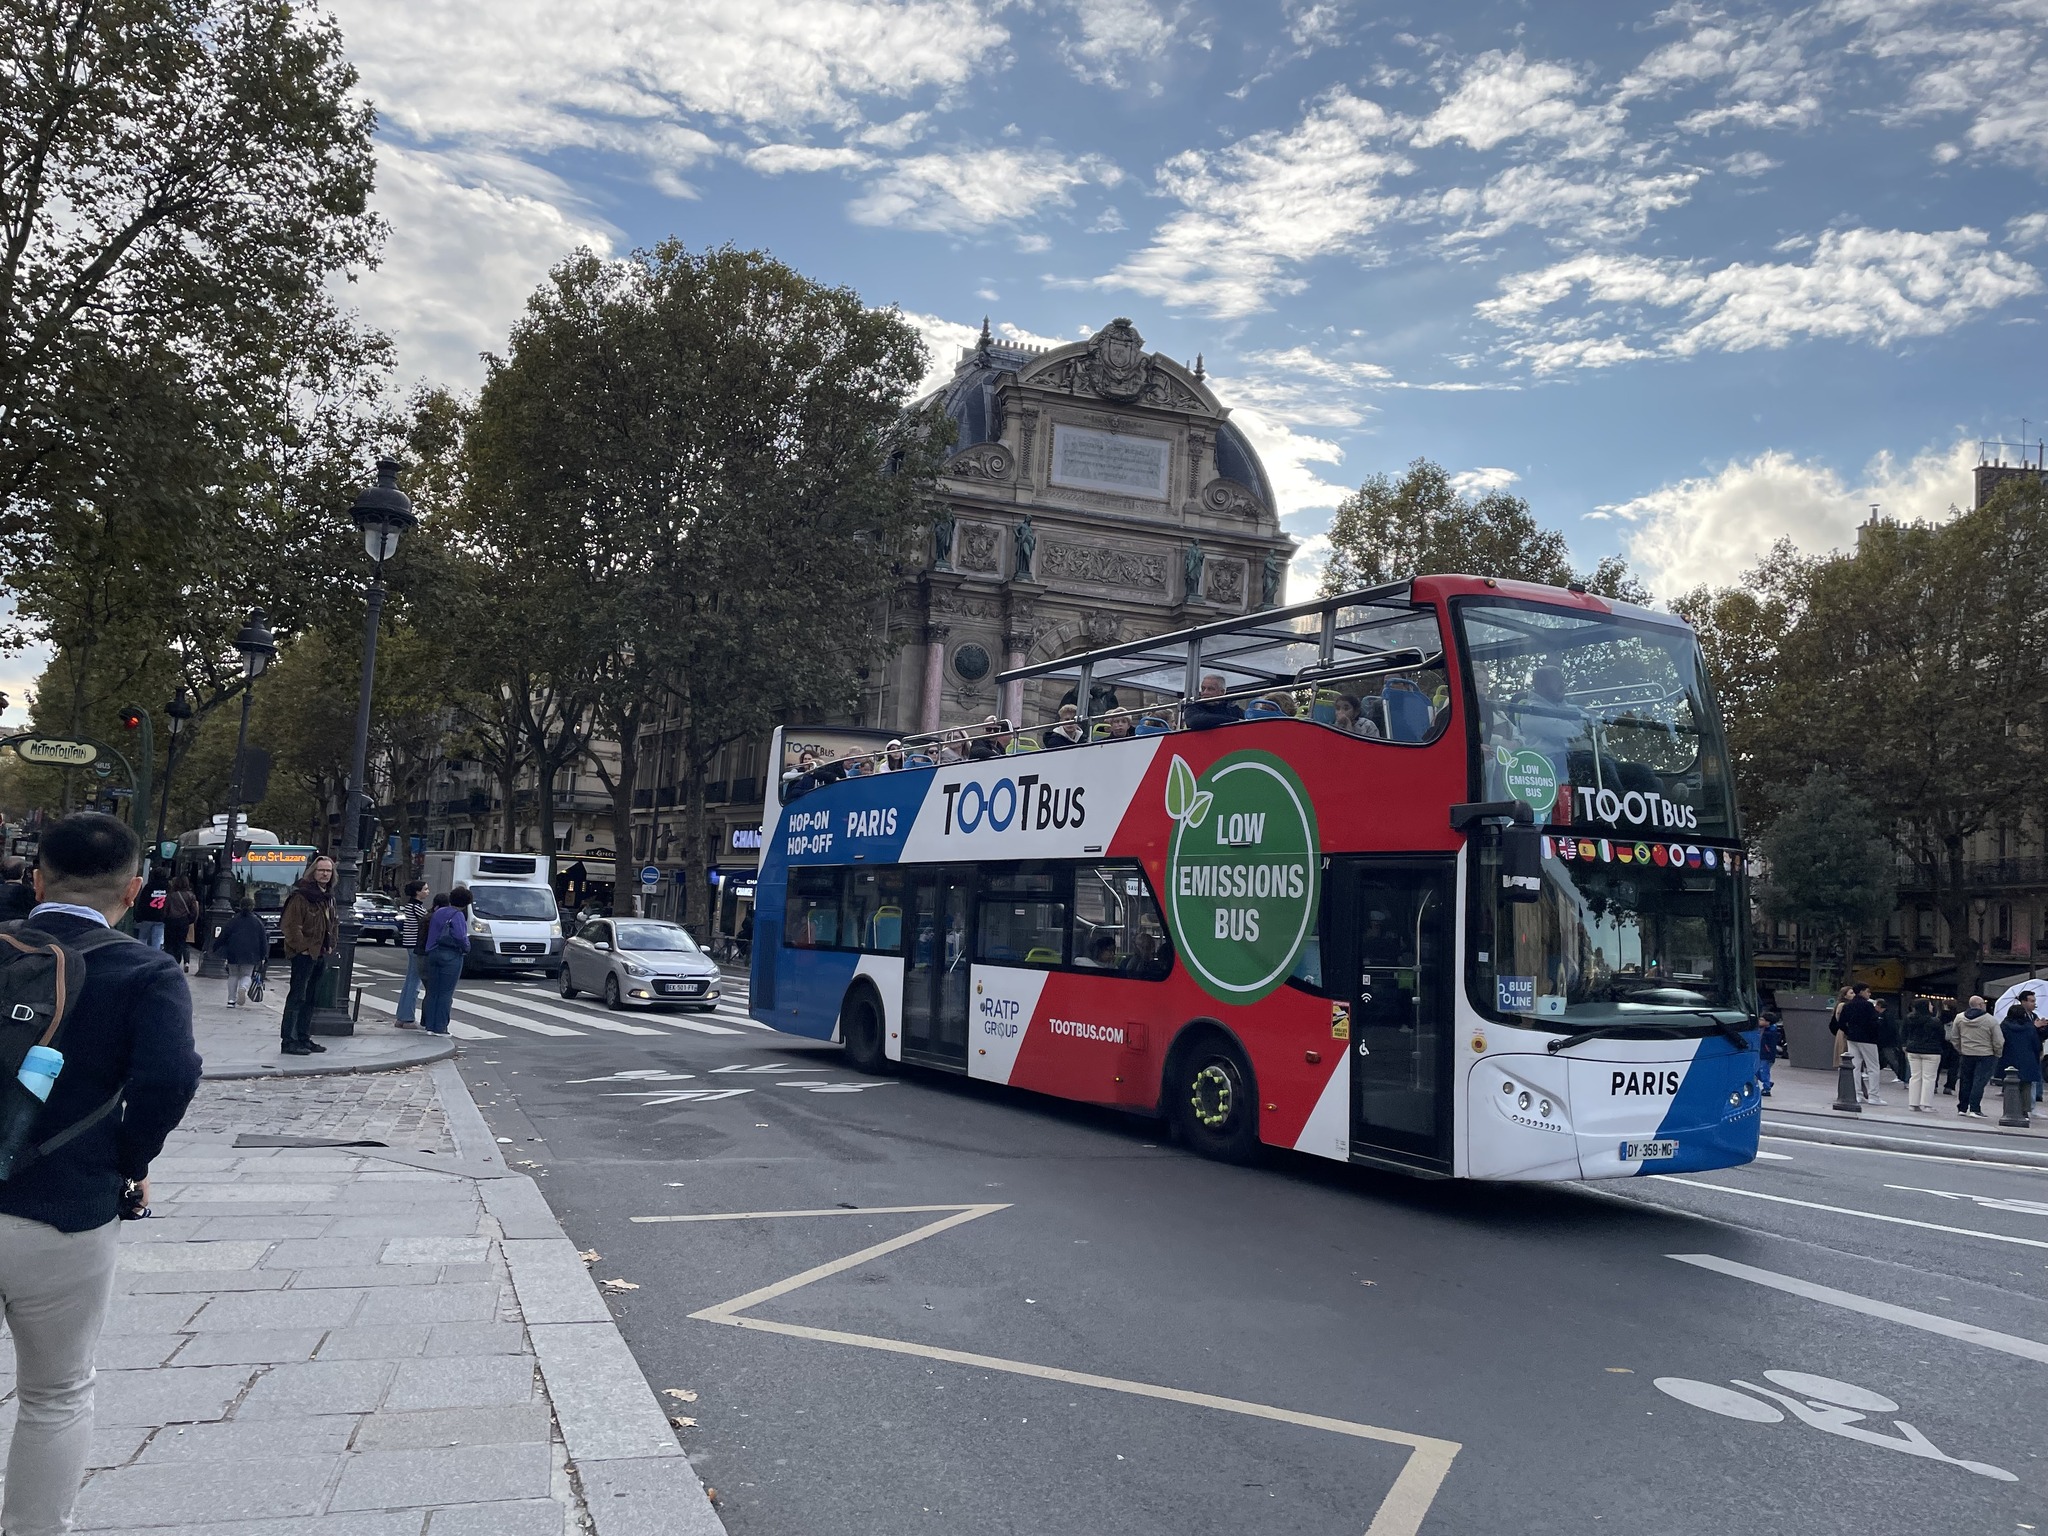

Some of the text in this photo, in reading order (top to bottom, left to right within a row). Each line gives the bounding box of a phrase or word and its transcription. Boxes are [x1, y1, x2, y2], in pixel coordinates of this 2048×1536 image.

[1522, 764, 1539, 774] LOW
[1509, 774, 1554, 787] EMISSIONS
[1526, 787, 1542, 797] BUS
[789, 810, 830, 833] HOP-ON
[847, 807, 898, 838] PARIS
[1216, 812, 1266, 845] LOW
[787, 833, 833, 855] HOP-OFF
[248, 852, 266, 861] Gare
[1179, 863, 1304, 898] EMISSIONS
[1215, 908, 1260, 942] BUS
[1509, 981, 1532, 992] BLUE
[985, 998, 1019, 1020] RATP
[1511, 996, 1531, 1006] LINE
[1049, 1018, 1124, 1044] TOOTBUS.COM
[1611, 1071, 1679, 1096] PARIS
